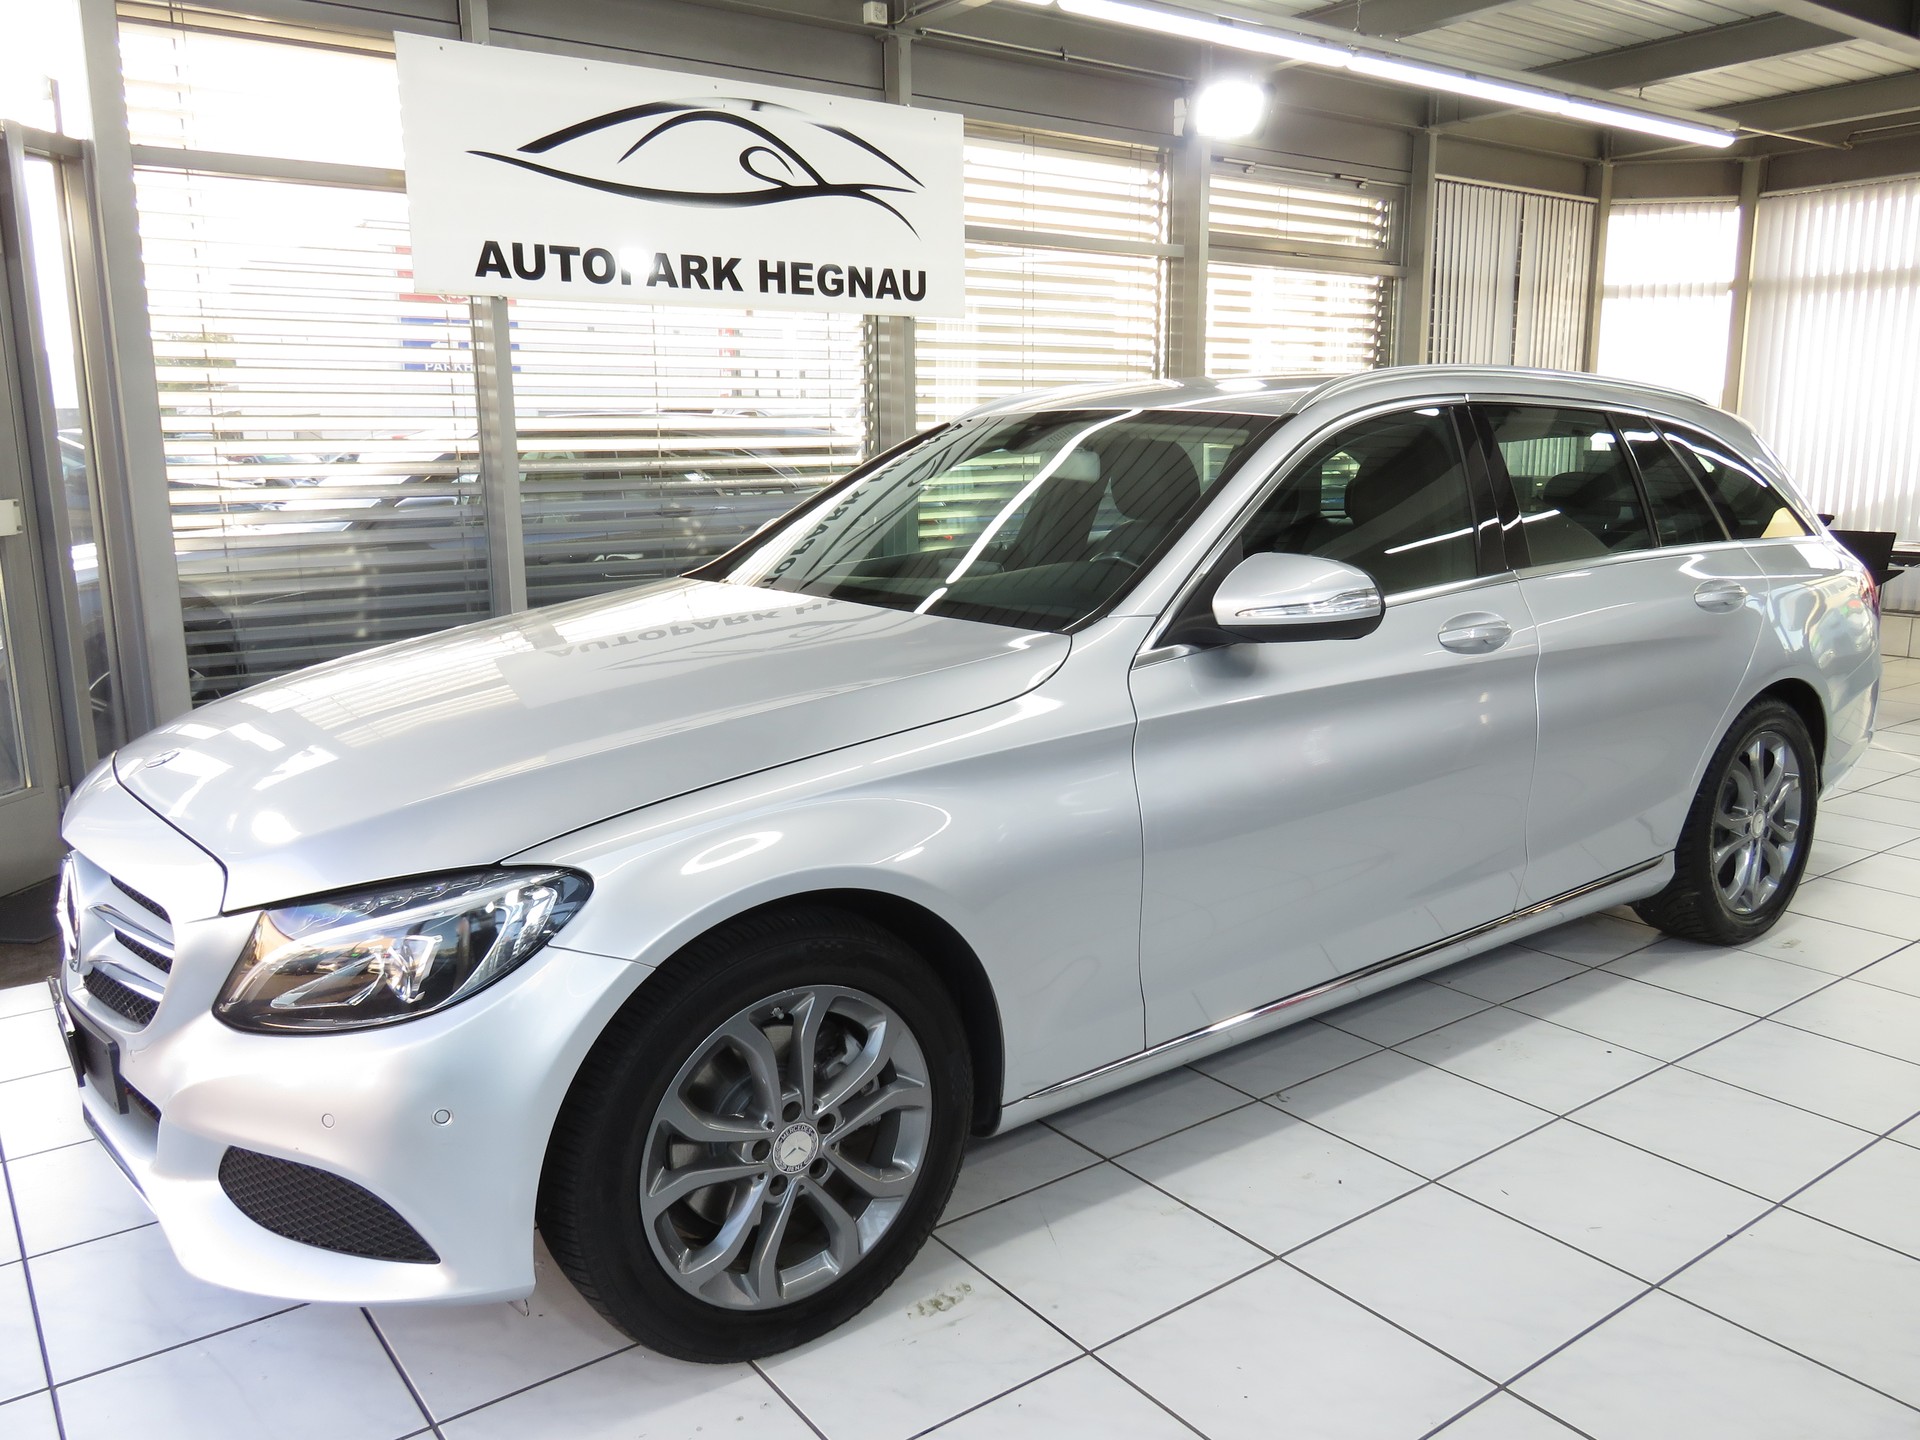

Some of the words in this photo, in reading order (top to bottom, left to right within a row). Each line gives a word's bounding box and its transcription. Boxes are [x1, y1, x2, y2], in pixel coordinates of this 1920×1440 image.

[758, 259, 926, 302] HEGNAU
[424, 362, 474, 372] PARKH
[780, 1125, 813, 1141] MERCEDES
